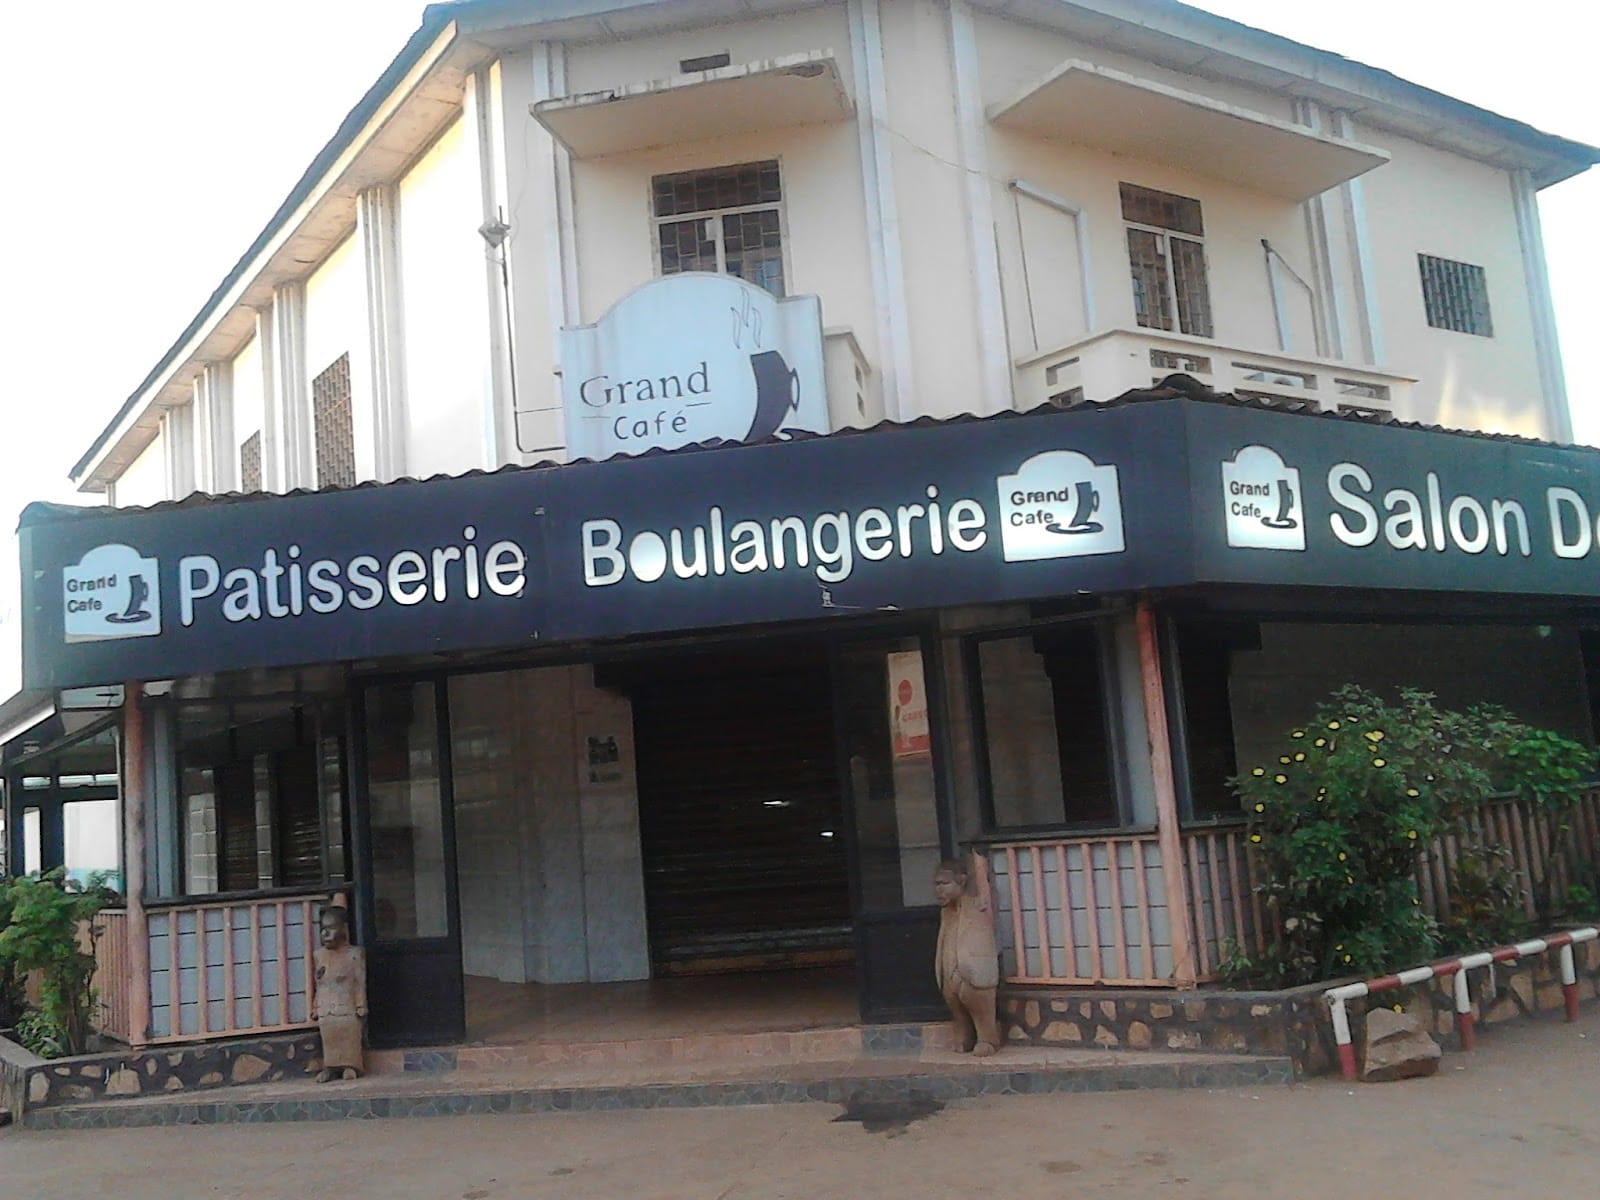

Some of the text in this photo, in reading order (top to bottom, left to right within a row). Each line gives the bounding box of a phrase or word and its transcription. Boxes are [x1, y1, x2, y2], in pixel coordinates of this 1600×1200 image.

[580, 361, 711, 407] Grand
[613, 410, 687, 440] Café
[1010, 486, 1069, 506] Grand
[1230, 480, 1270, 496] Grand
[1010, 509, 1054, 527] Cafe
[1231, 501, 1261, 518] Cafe
[1328, 462, 1600, 559] Salon D
[180, 484, 988, 627] Patisserie Boulangerie
[66, 573, 117, 593] Grand
[67, 597, 102, 613] Cafe
